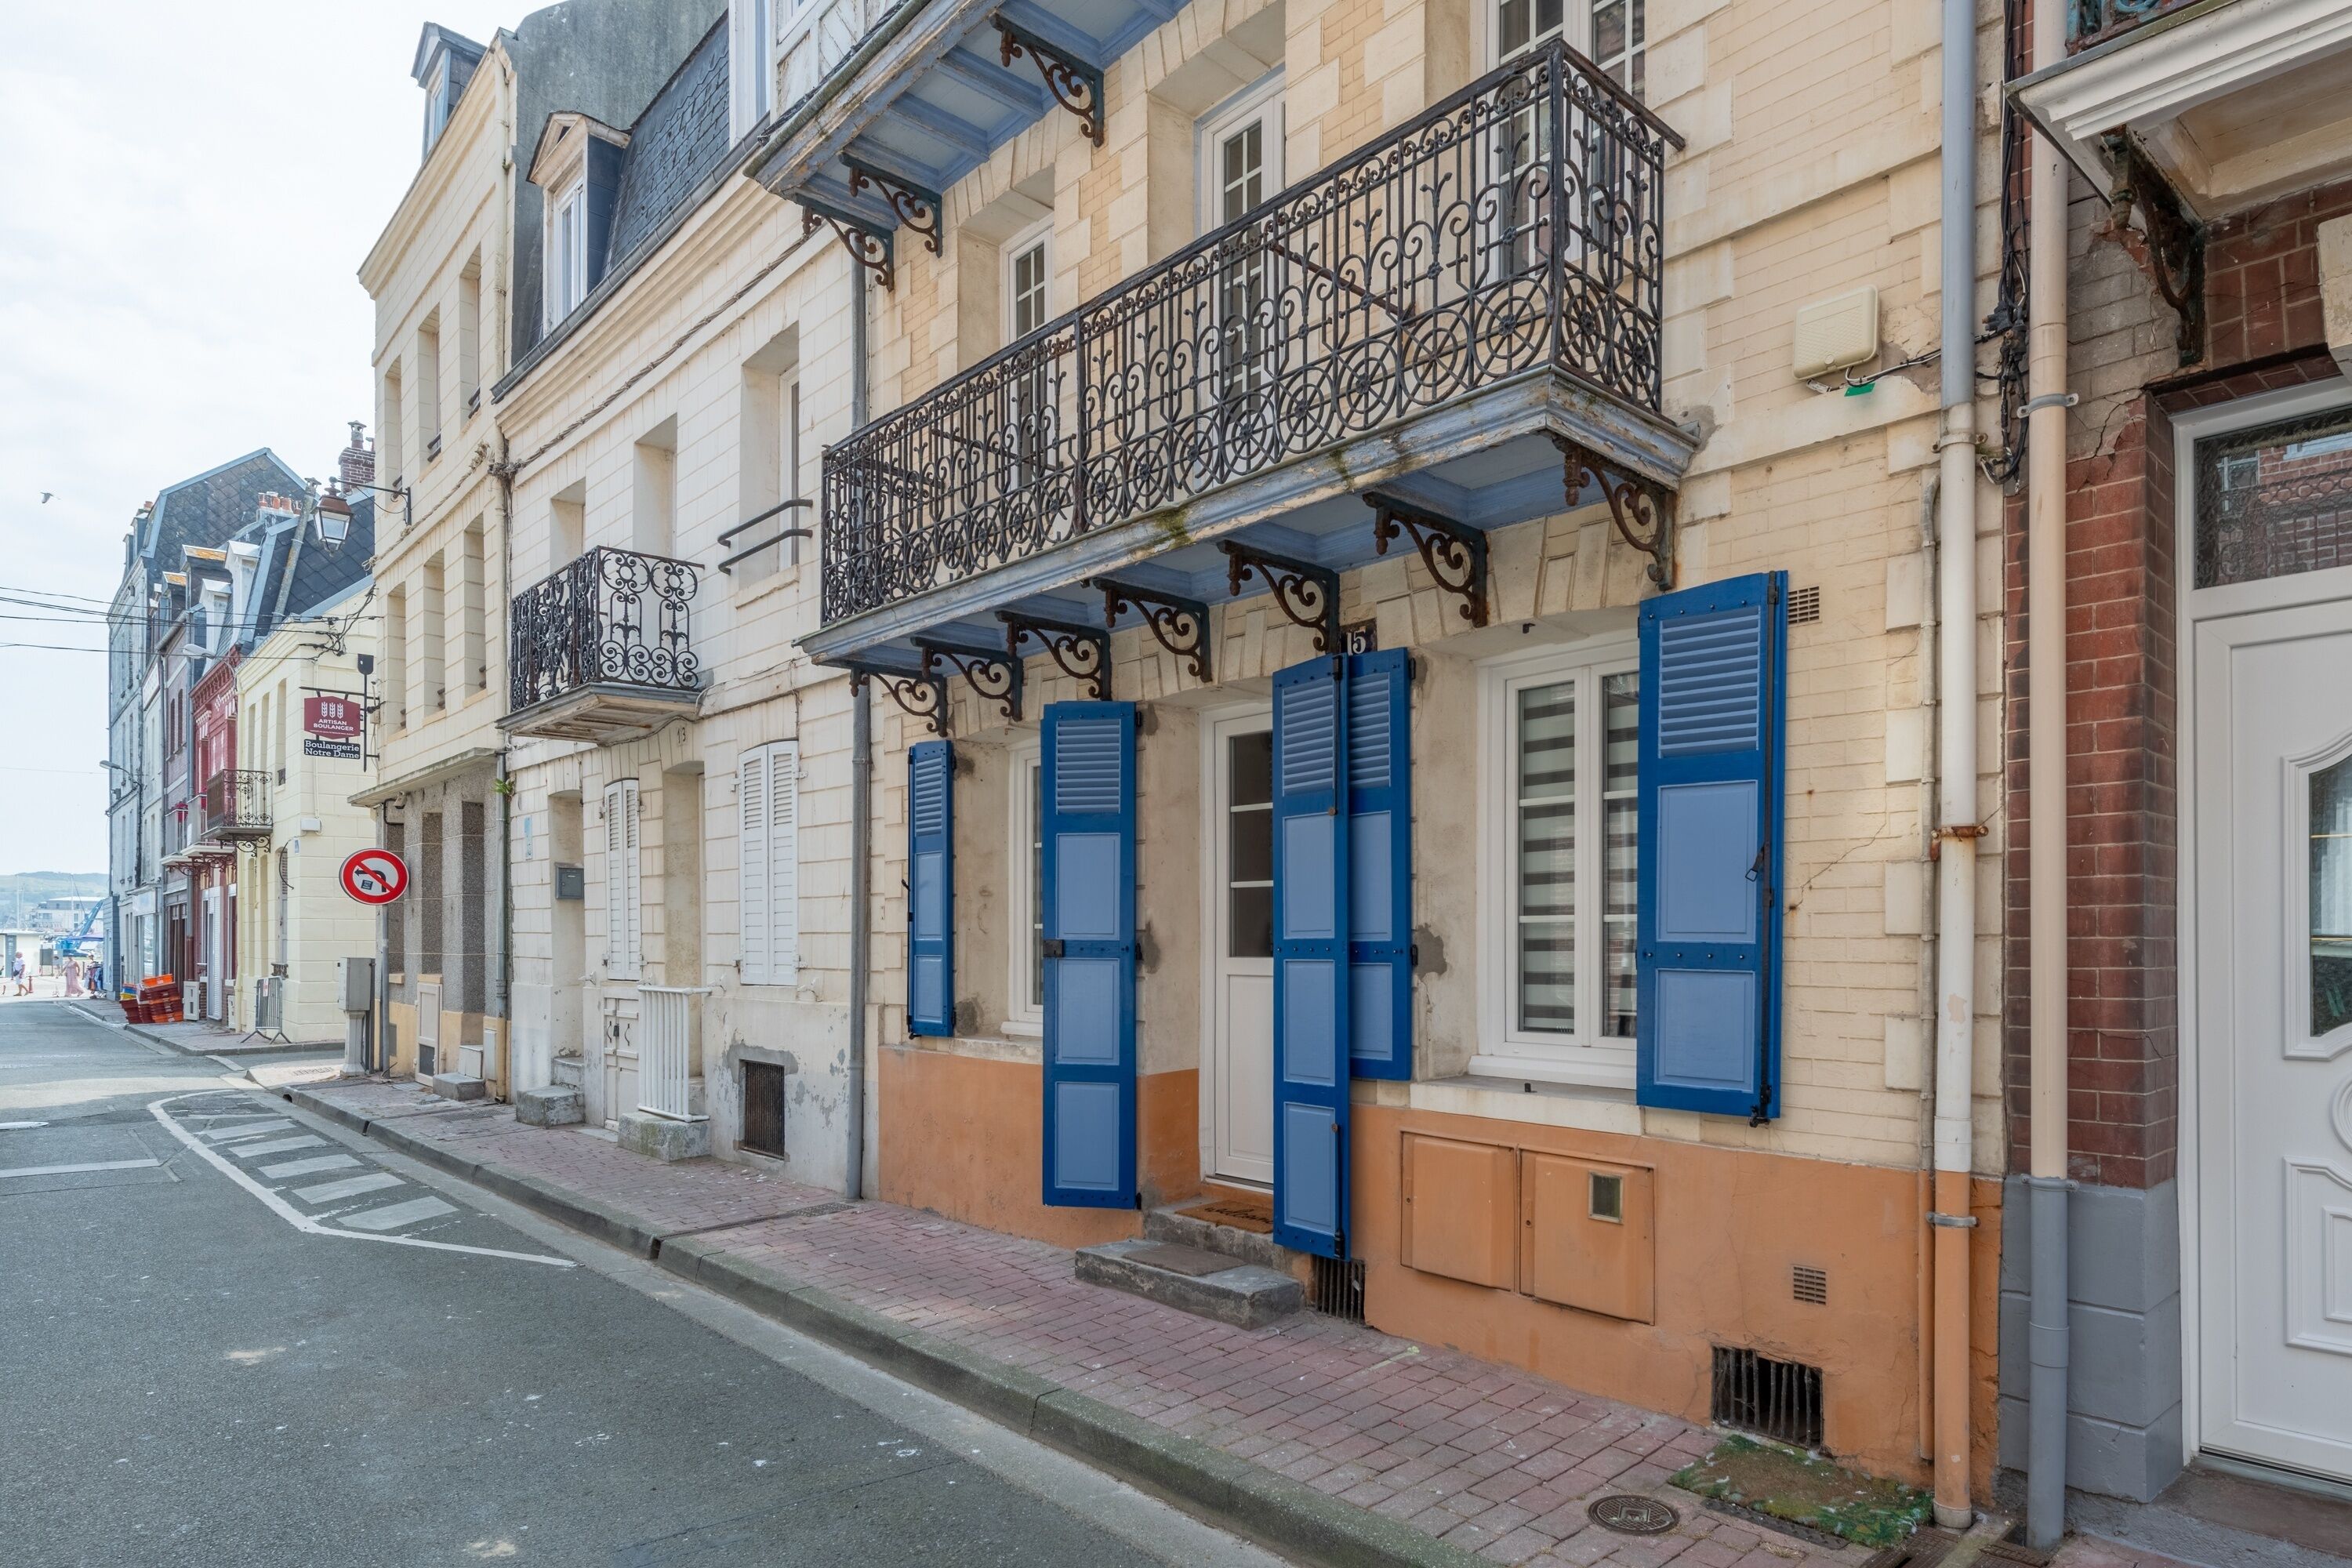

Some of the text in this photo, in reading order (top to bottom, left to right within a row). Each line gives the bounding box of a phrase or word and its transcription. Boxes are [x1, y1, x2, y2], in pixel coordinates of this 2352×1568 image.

[1346, 626, 1367, 656] 15
[314, 723, 354, 731] BOULANGER
[677, 727, 686, 744] 13
[305, 740, 360, 752] Boulangerie
[305, 748, 360, 759] Notre Dame
